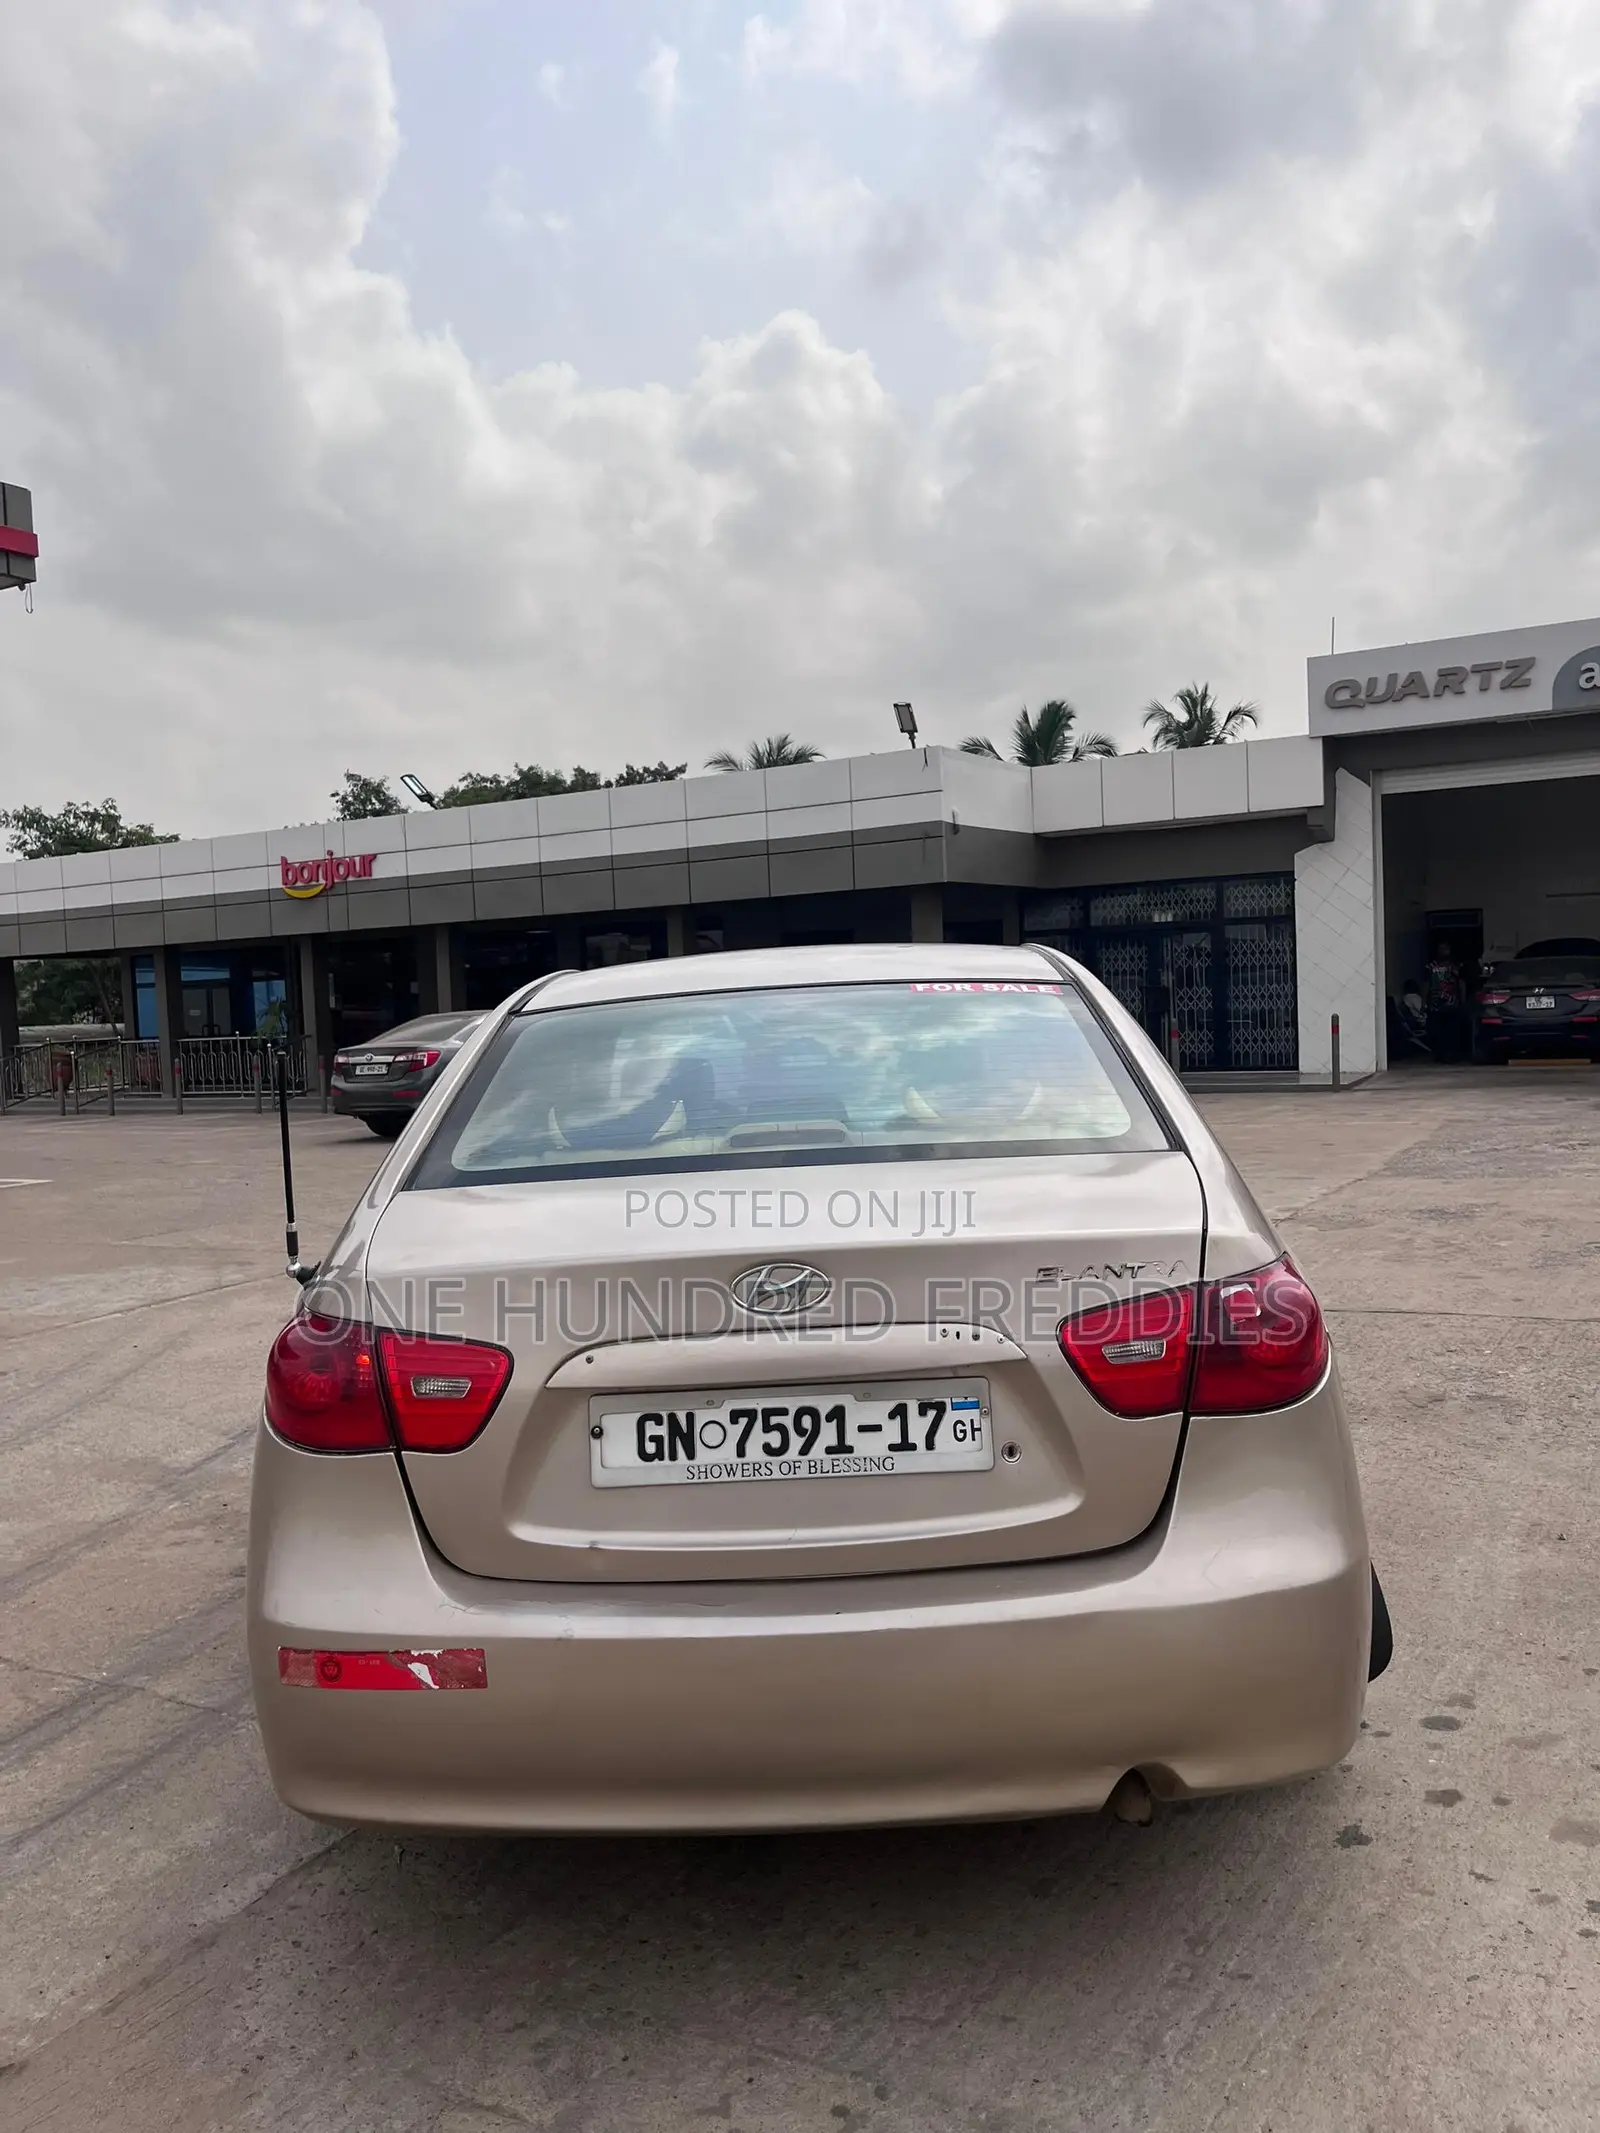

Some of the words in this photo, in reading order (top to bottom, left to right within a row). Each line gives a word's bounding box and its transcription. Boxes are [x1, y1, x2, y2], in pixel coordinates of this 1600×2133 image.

[1325, 656, 1536, 709] QUARTZ
[281, 850, 377, 890] bonjour
[914, 983, 974, 993] FOR
[983, 984, 1056, 994] SALE
[636, 1412, 696, 1462] GN
[729, 1401, 947, 1458] 7591-17
[686, 1461, 773, 1480] SHOWERS
[779, 1460, 802, 1476] OF
[808, 1456, 895, 1475] BLESSING
